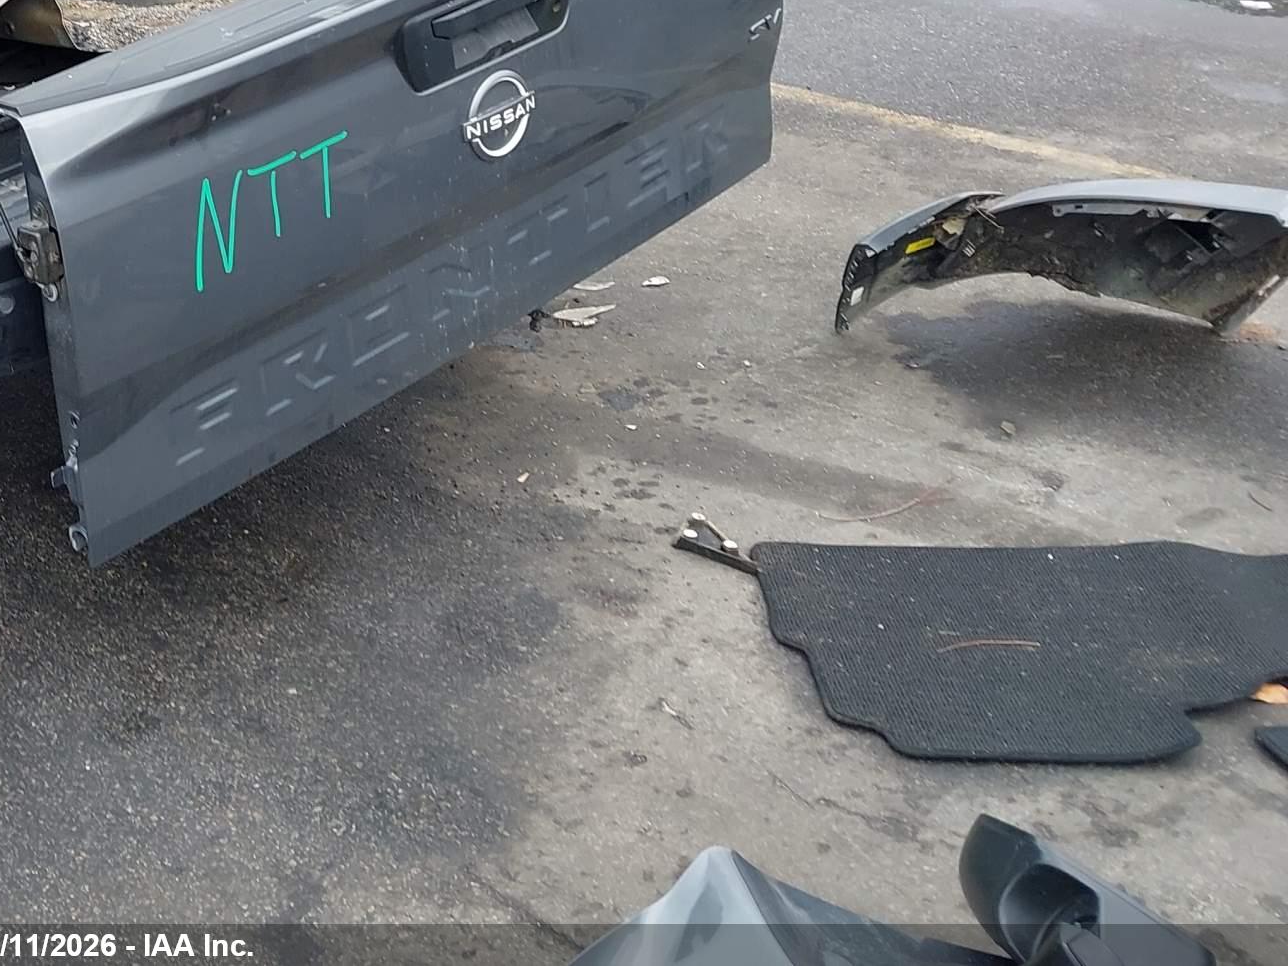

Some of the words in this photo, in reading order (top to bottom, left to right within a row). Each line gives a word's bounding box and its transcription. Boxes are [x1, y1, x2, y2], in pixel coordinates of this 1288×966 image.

[465, 93, 536, 140] NISSAN
[167, 102, 730, 467] FRONTIER
[195, 130, 349, 293] NTT
